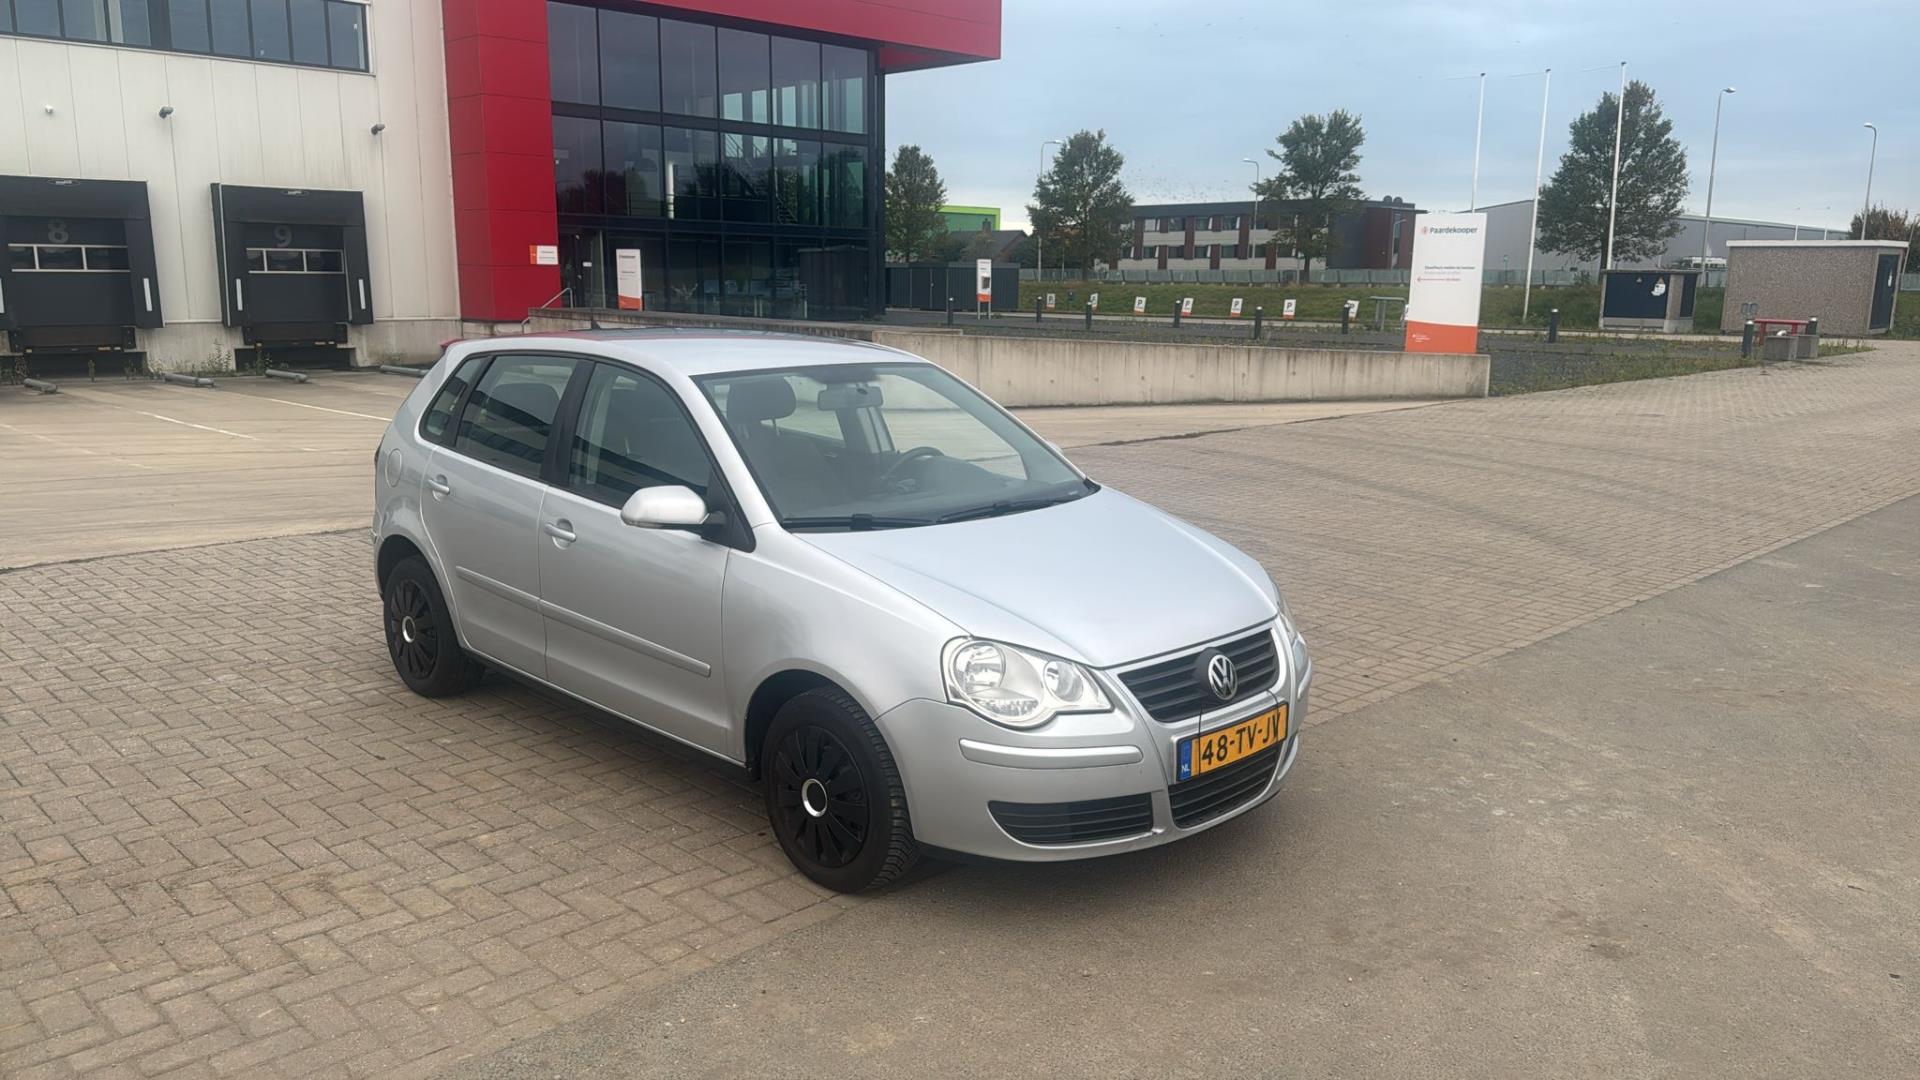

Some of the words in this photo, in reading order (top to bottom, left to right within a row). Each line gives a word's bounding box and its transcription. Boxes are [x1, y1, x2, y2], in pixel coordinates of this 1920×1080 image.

[48, 219, 69, 244] 8
[274, 224, 292, 248] 9
[1430, 226, 1478, 234] Paardekooper
[1202, 712, 1281, 765] 48-TV-JV
[1181, 764, 1190, 773] NL
